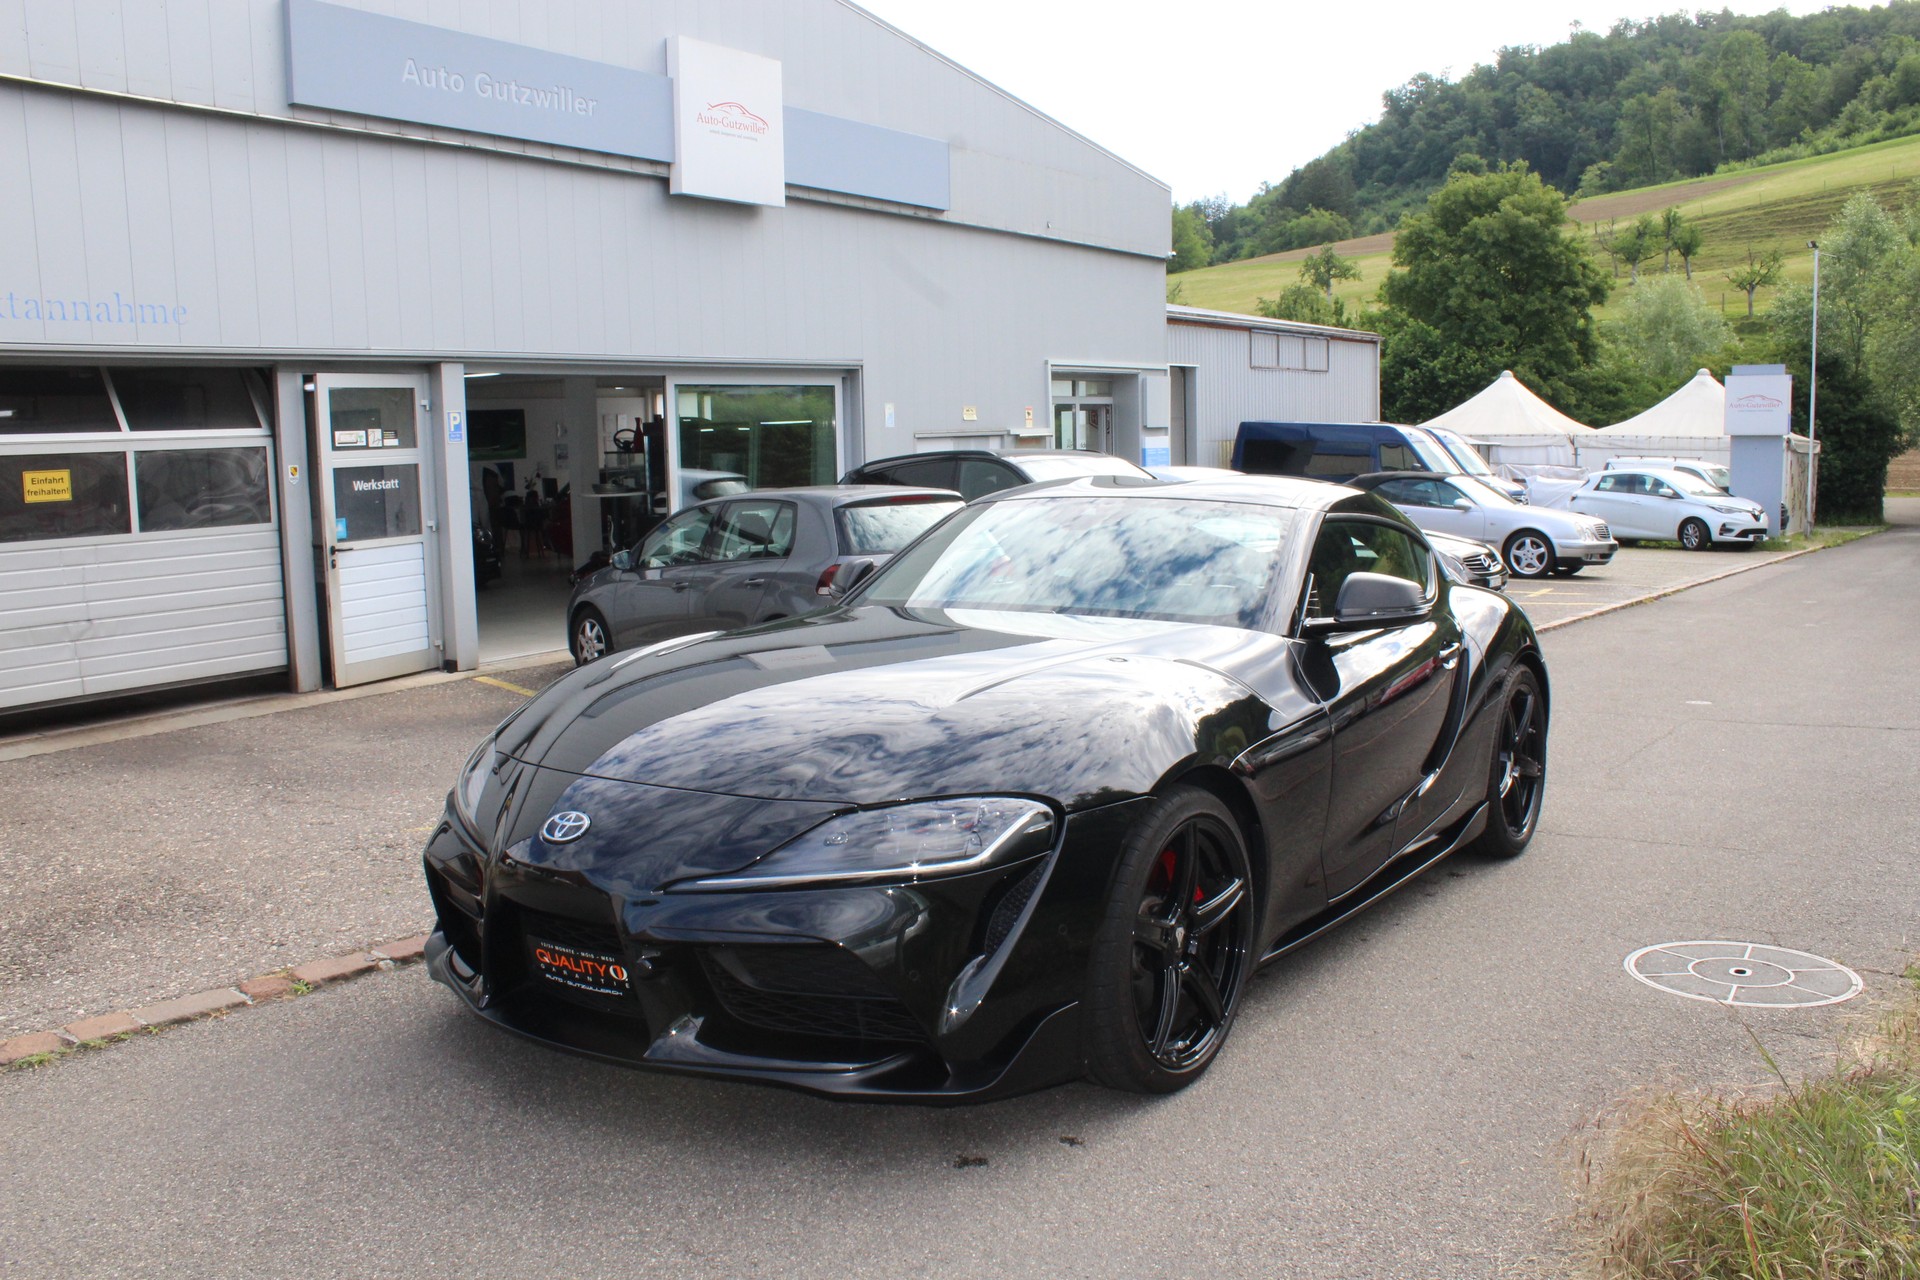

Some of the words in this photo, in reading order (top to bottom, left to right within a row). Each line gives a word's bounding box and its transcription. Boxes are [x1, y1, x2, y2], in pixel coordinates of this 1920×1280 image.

[401, 57, 465, 93] Auto
[474, 71, 598, 117] Gutzwiller
[696, 111, 766, 135] Auto-Gutzwiller
[450, 412, 461, 432] P
[27, 487, 70, 496] freihalten!
[31, 477, 65, 485] Einfahrt
[352, 479, 400, 491] Werkstatt
[535, 948, 606, 977] QUALITY
[540, 963, 631, 989] GARANTIE
